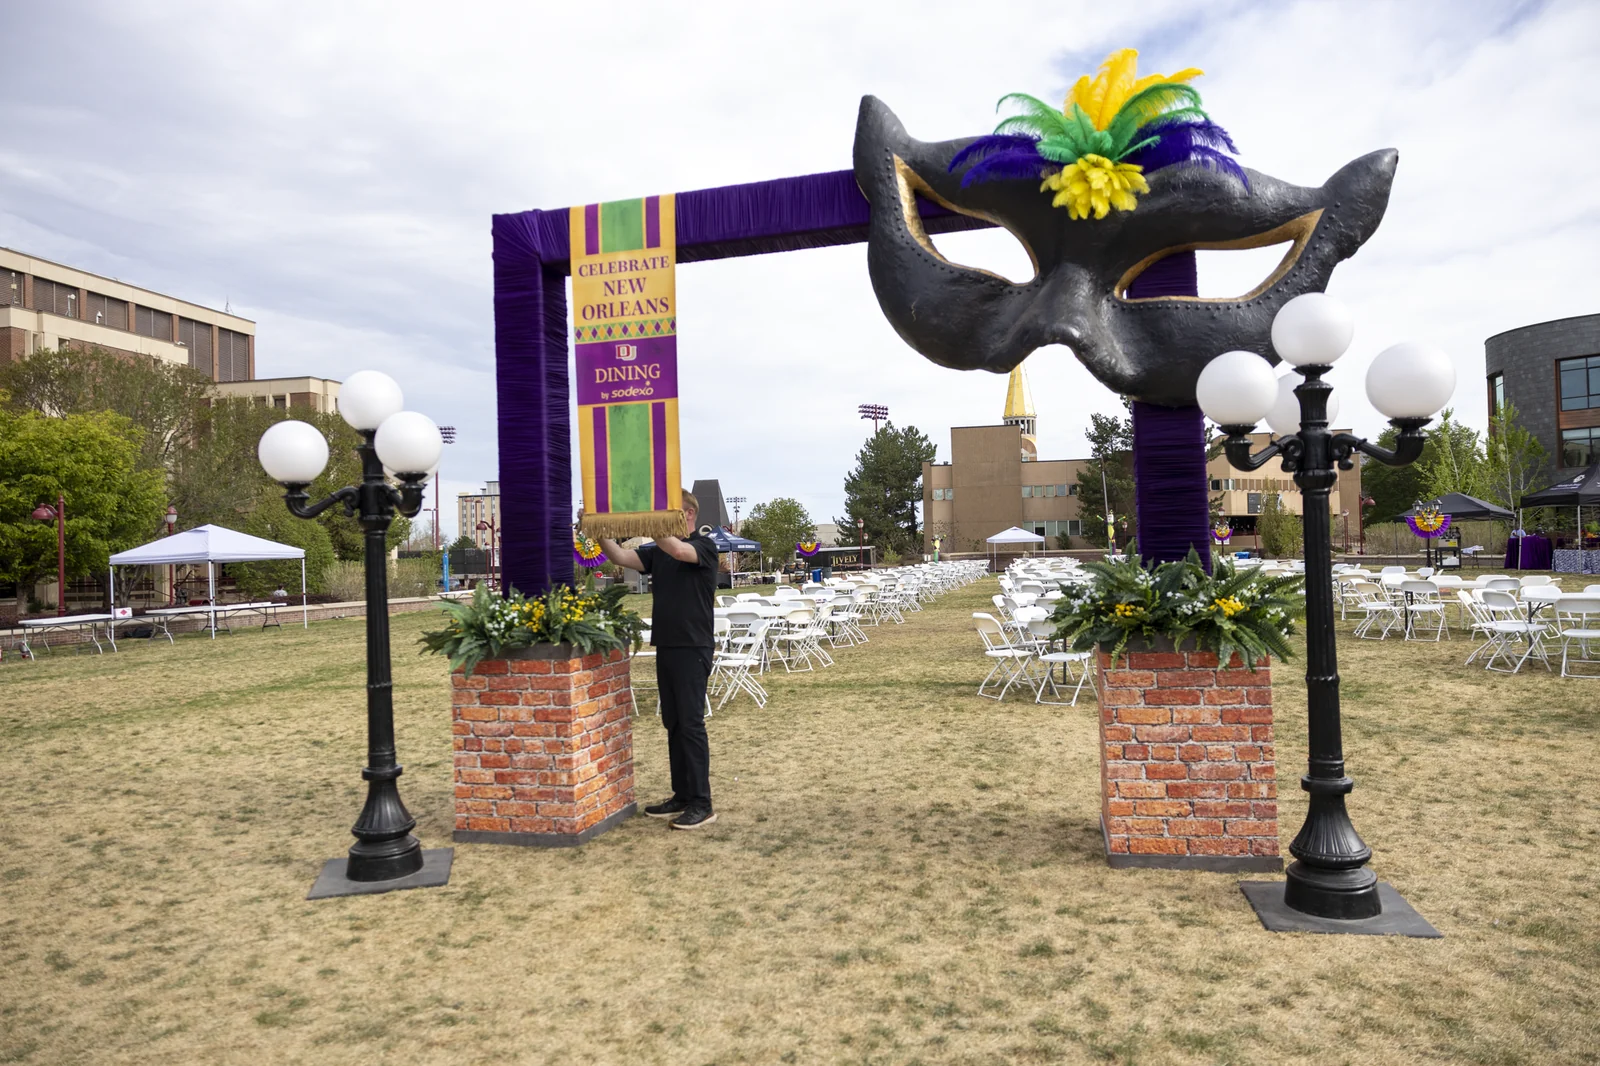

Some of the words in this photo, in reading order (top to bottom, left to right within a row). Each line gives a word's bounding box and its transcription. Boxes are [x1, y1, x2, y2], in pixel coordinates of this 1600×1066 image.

[578, 256, 670, 277] CELEBRATE
[603, 277, 647, 296] NEW
[582, 297, 669, 320] ORLEANS
[595, 363, 661, 383] DINING
[601, 391, 609, 400] by
[611, 385, 654, 398] sodexo
